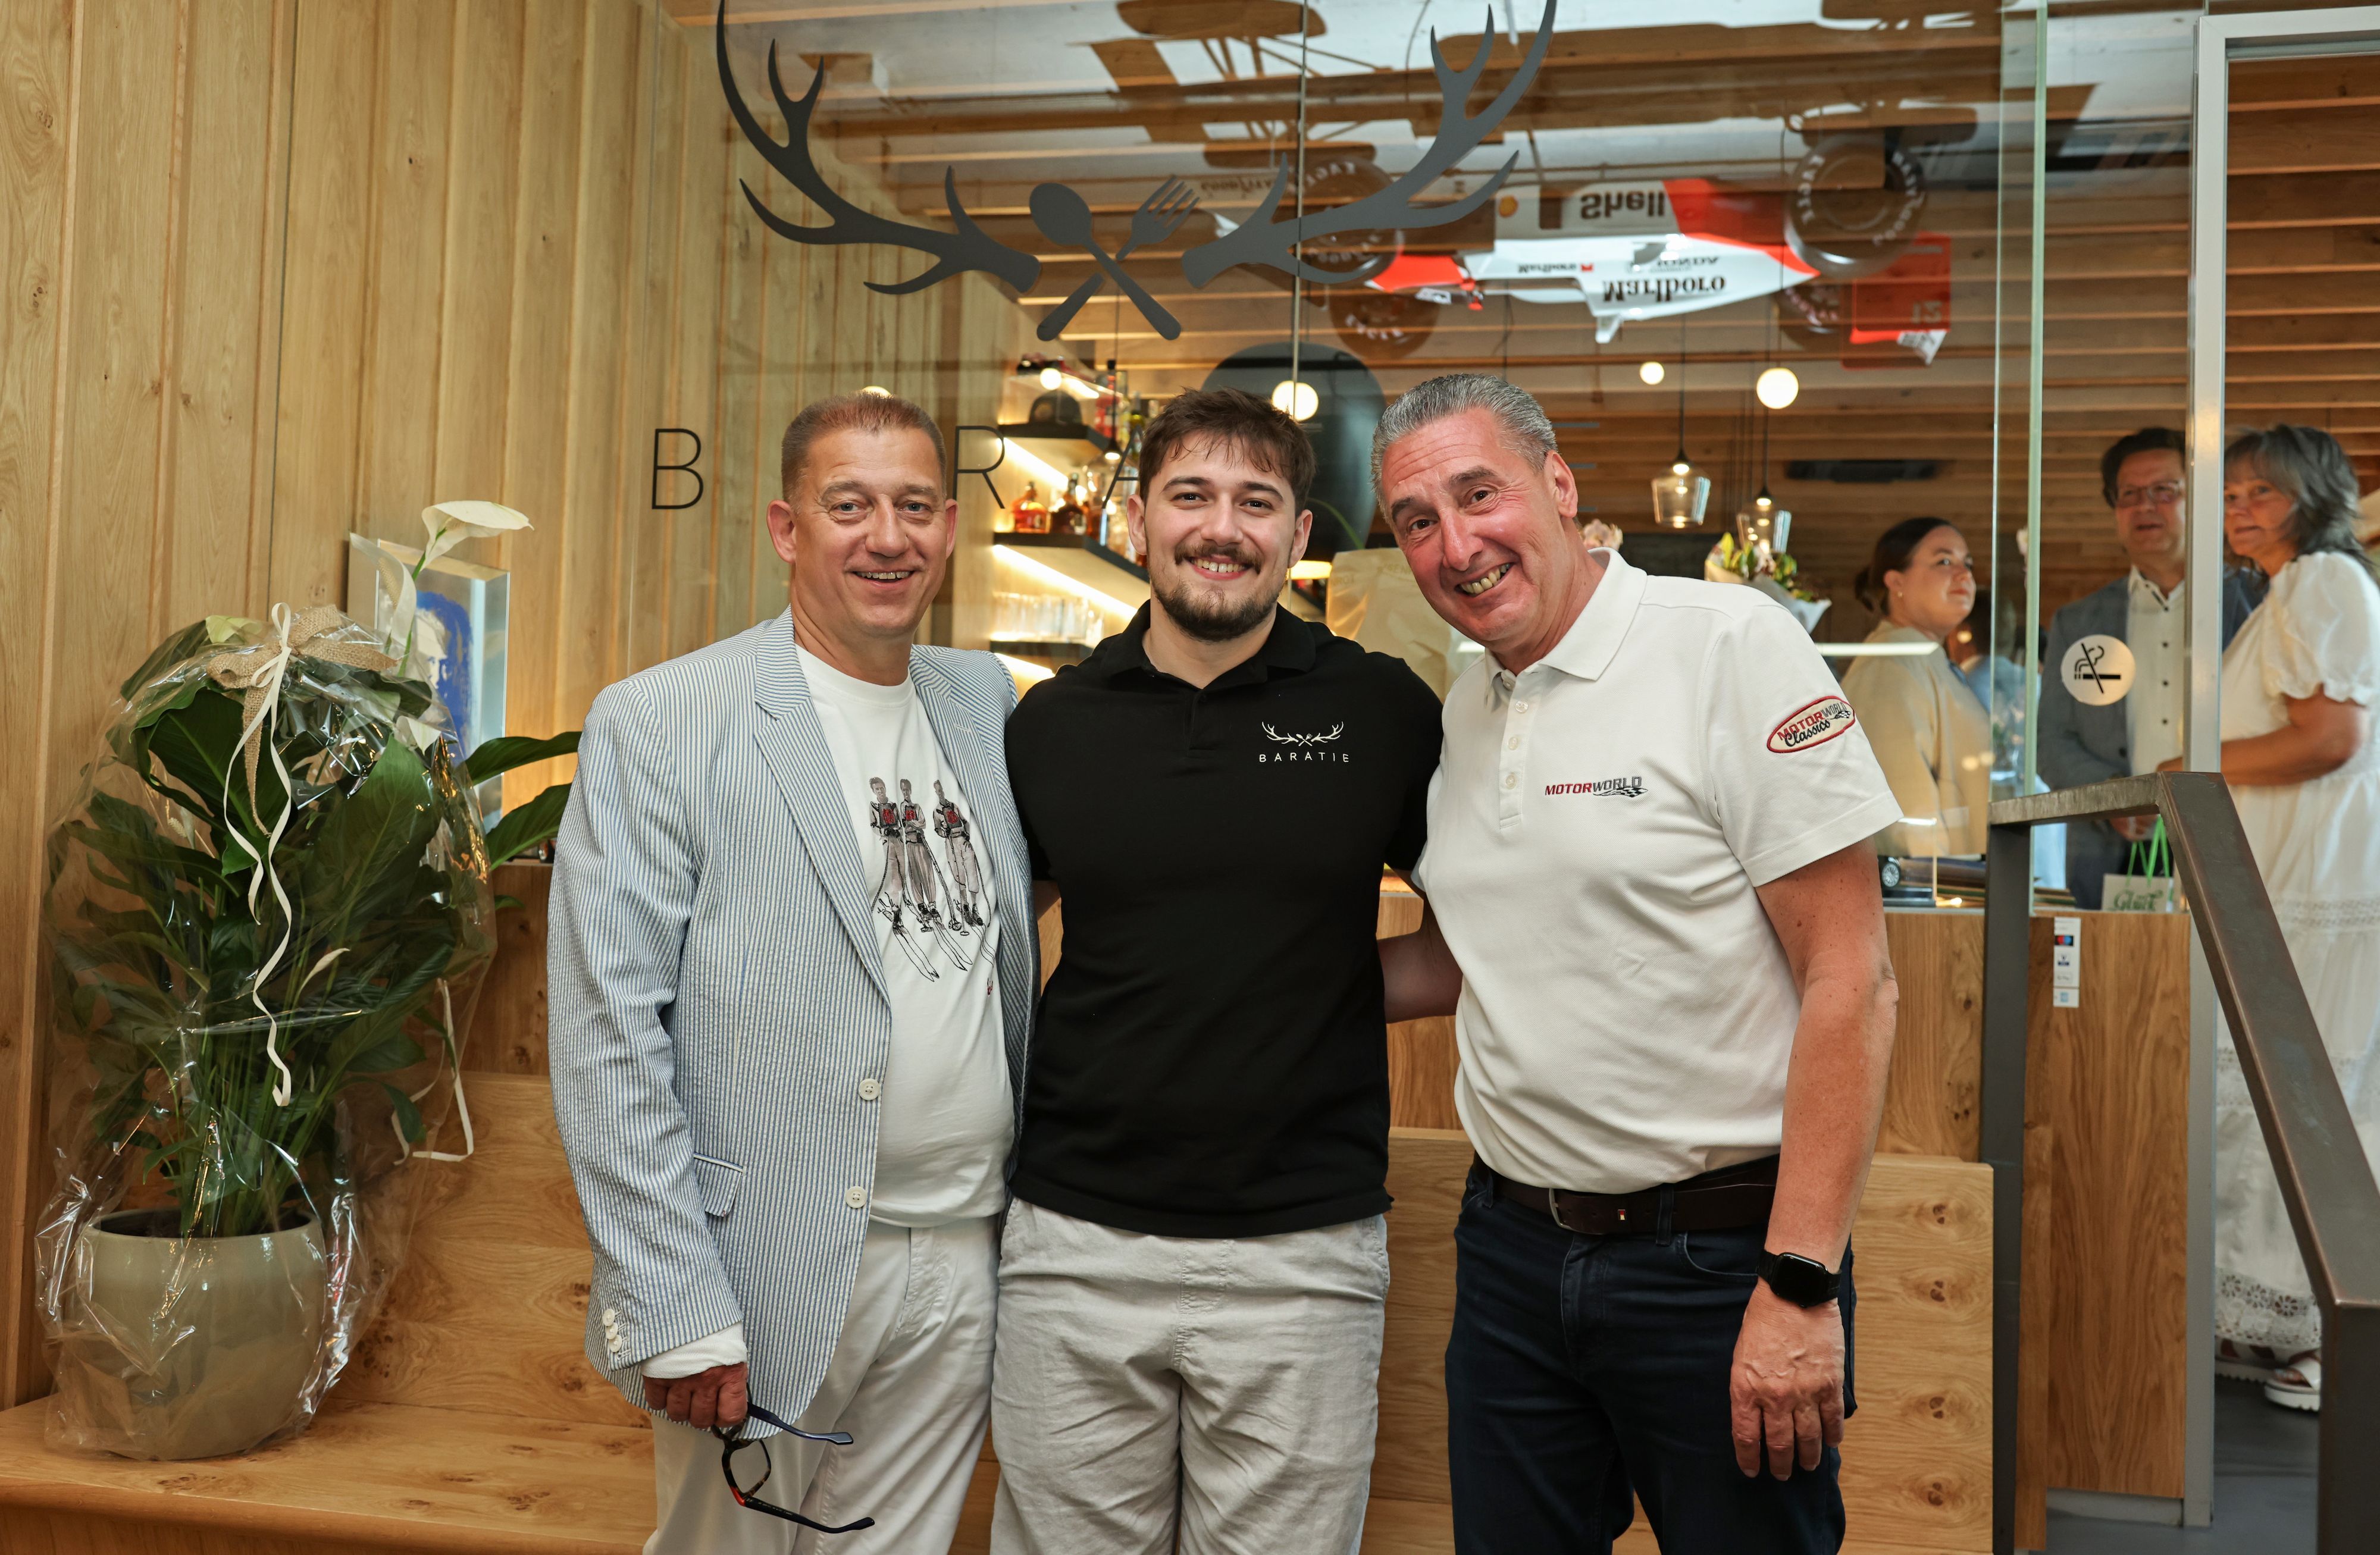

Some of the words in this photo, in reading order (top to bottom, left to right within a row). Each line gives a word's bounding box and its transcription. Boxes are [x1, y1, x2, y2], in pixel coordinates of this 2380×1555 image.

[1777, 702, 1847, 741] MOTORWORLD
[1784, 719, 1831, 747] Classics
[1258, 751, 1349, 763] BARATIE
[1545, 776, 1642, 796] MOTORWORLD
